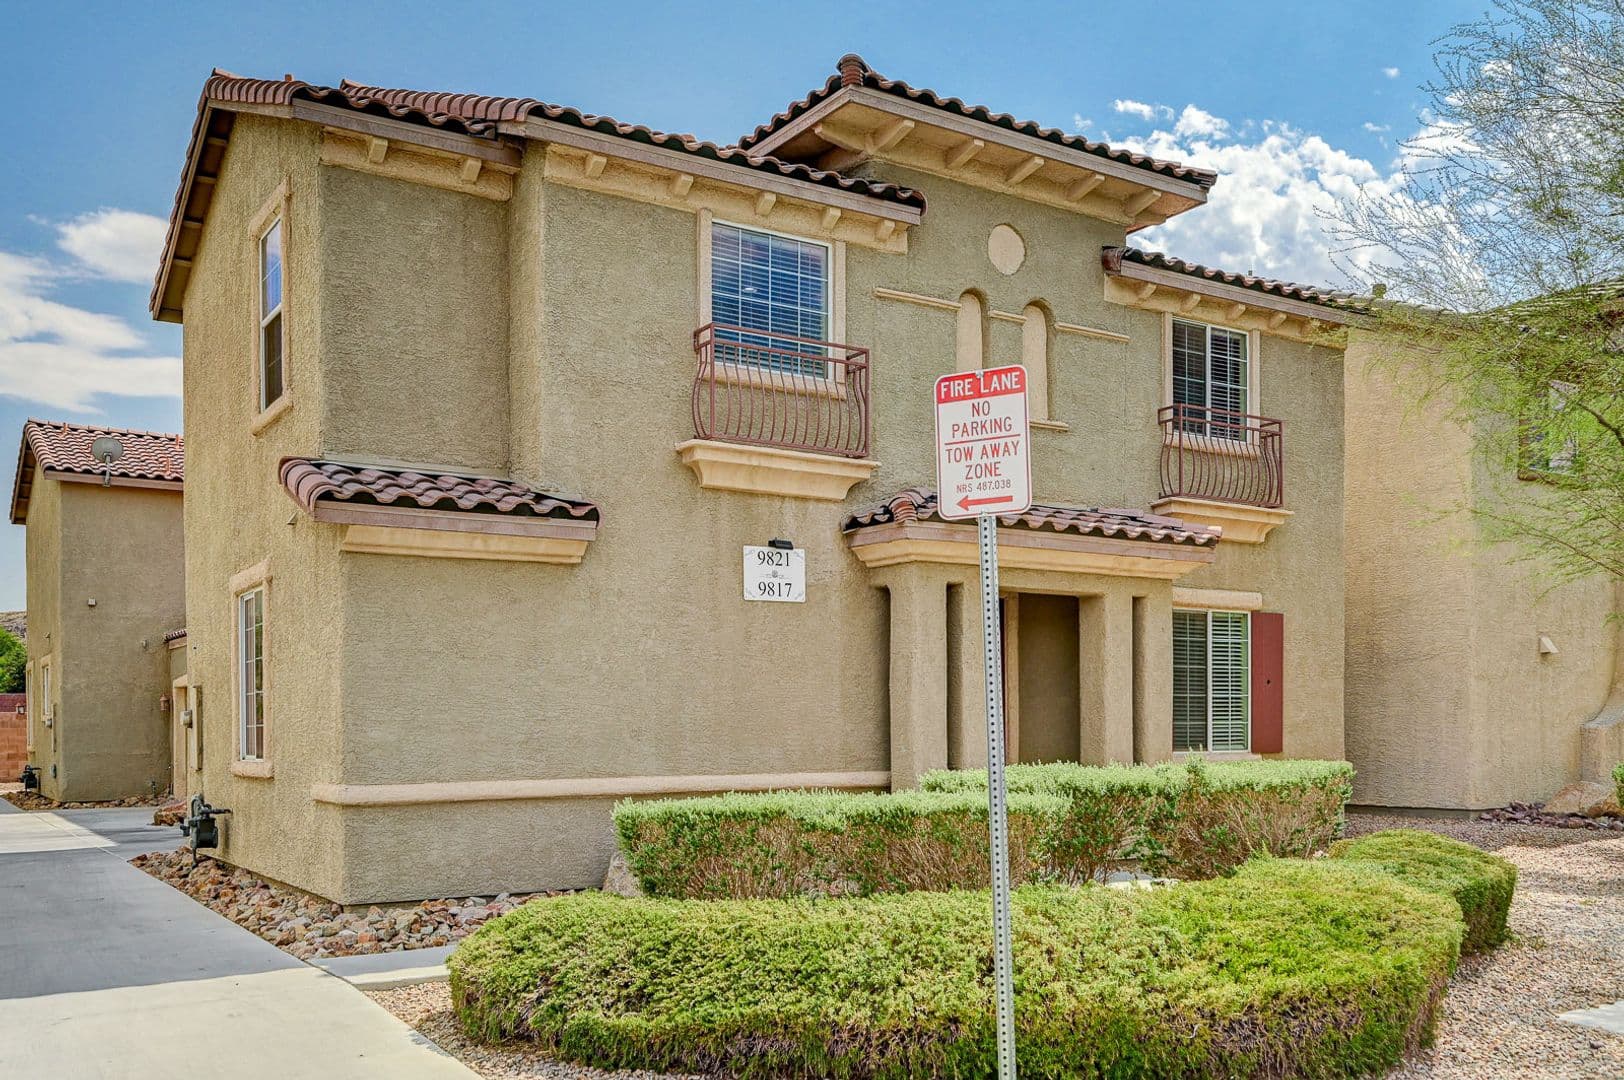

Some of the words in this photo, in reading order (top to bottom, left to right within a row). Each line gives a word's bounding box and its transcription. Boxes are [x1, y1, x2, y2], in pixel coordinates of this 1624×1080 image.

[940, 379, 974, 399] FIRE
[980, 371, 1021, 394] LANE
[971, 401, 991, 417] NO
[952, 416, 1013, 439] PARKING
[945, 445, 974, 464] TOW
[980, 440, 1020, 460] AWAY
[965, 461, 1002, 480] ZONE
[956, 482, 973, 494] NRS
[976, 479, 1011, 492] 487.038
[757, 550, 790, 566] 9821
[758, 581, 792, 597] 9817
